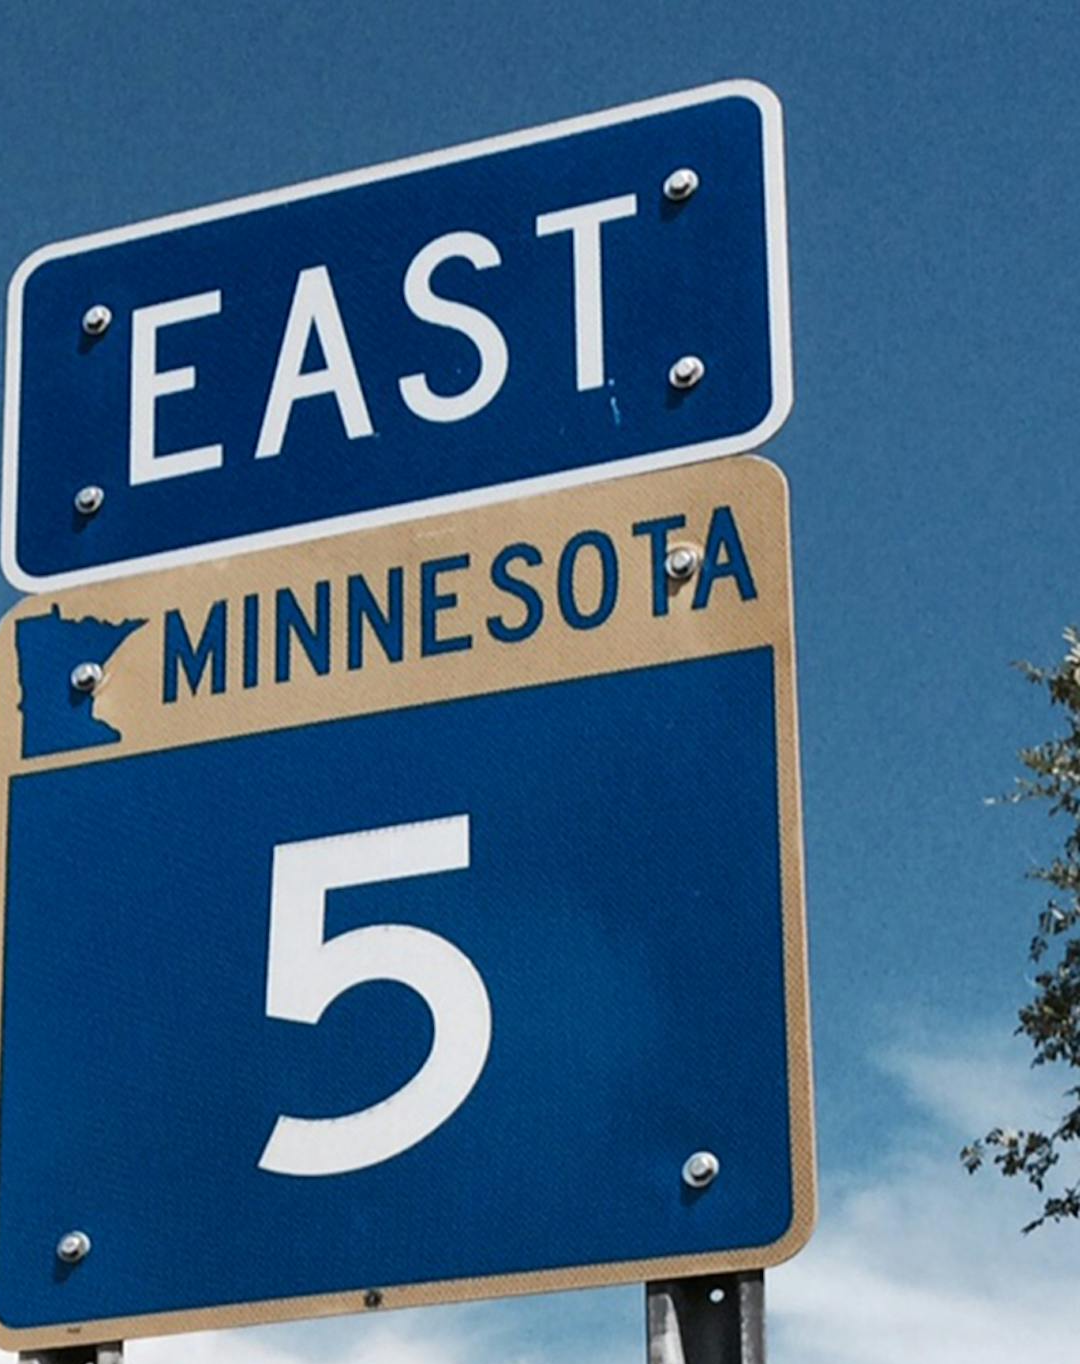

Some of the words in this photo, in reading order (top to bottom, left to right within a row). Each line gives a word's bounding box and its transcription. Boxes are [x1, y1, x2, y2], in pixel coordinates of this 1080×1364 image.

[130, 194, 637, 486] EAST
[162, 505, 757, 704] MINNESOTA
[258, 813, 492, 1177] 5
